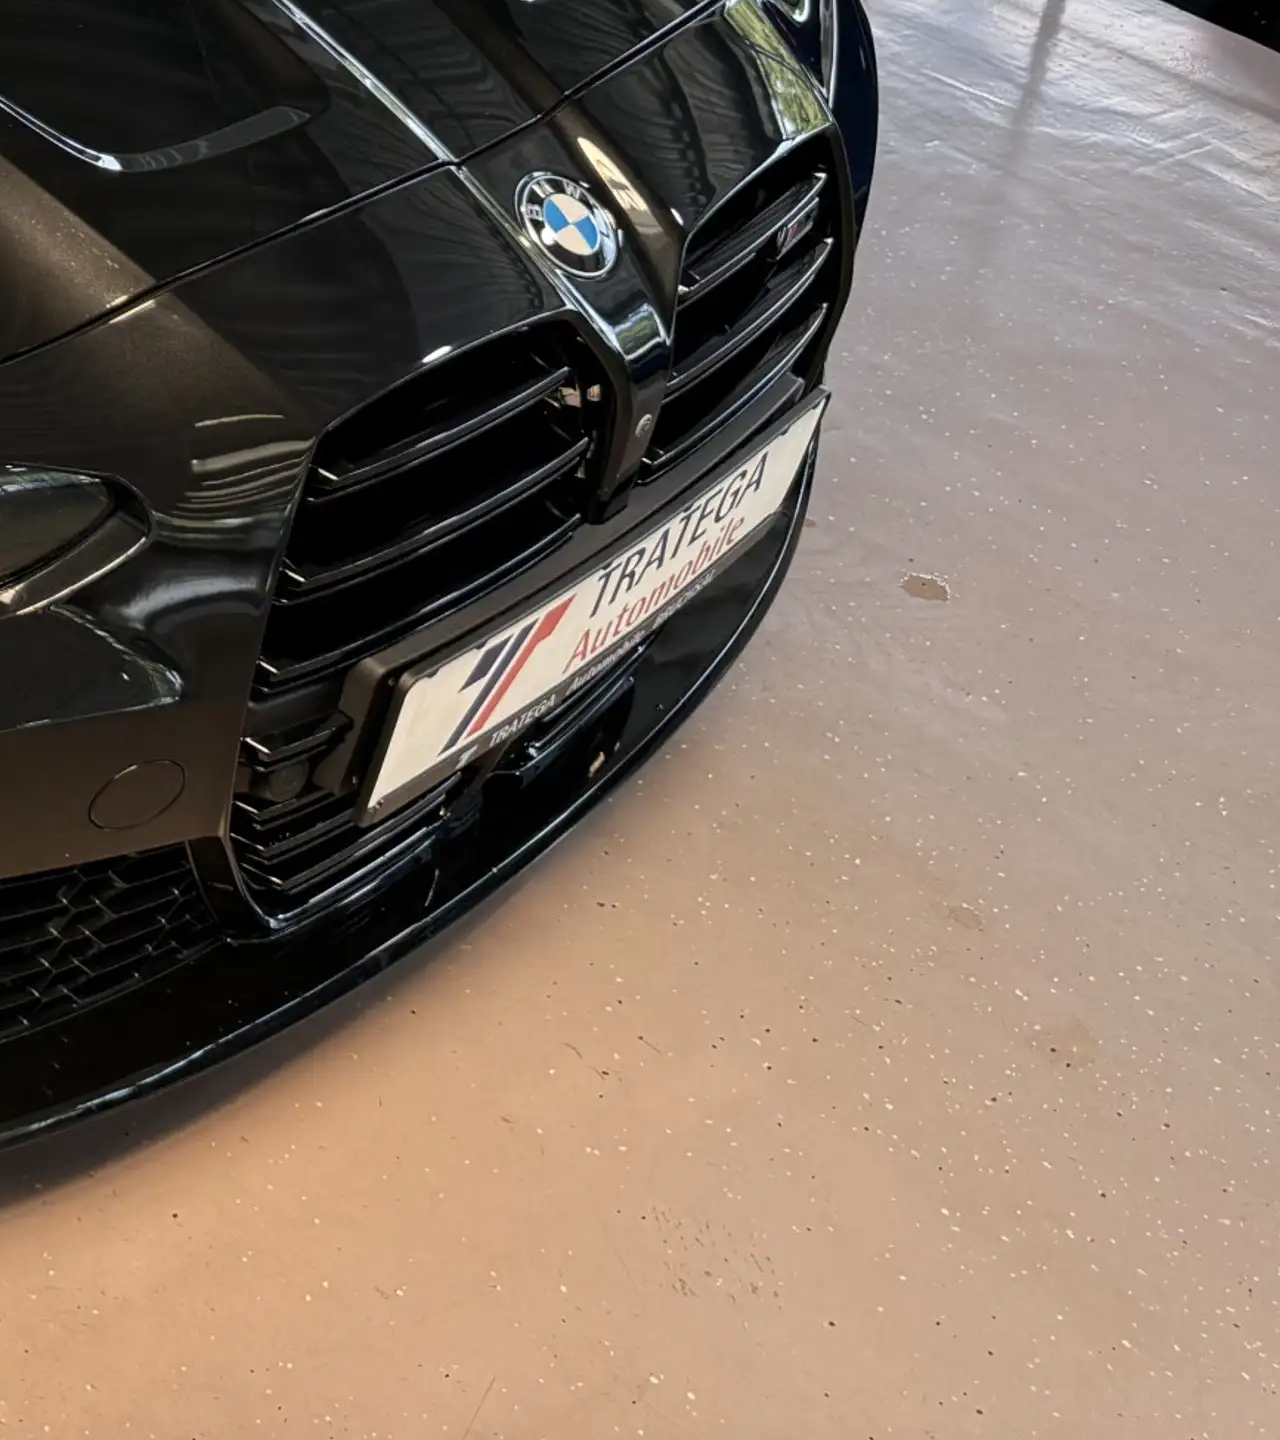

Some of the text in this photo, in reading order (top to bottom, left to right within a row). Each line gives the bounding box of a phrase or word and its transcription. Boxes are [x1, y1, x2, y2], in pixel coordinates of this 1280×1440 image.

[562, 516, 745, 674] Automobile
[589, 451, 769, 619] TRATEGA
[489, 694, 556, 748] TRATEGA
